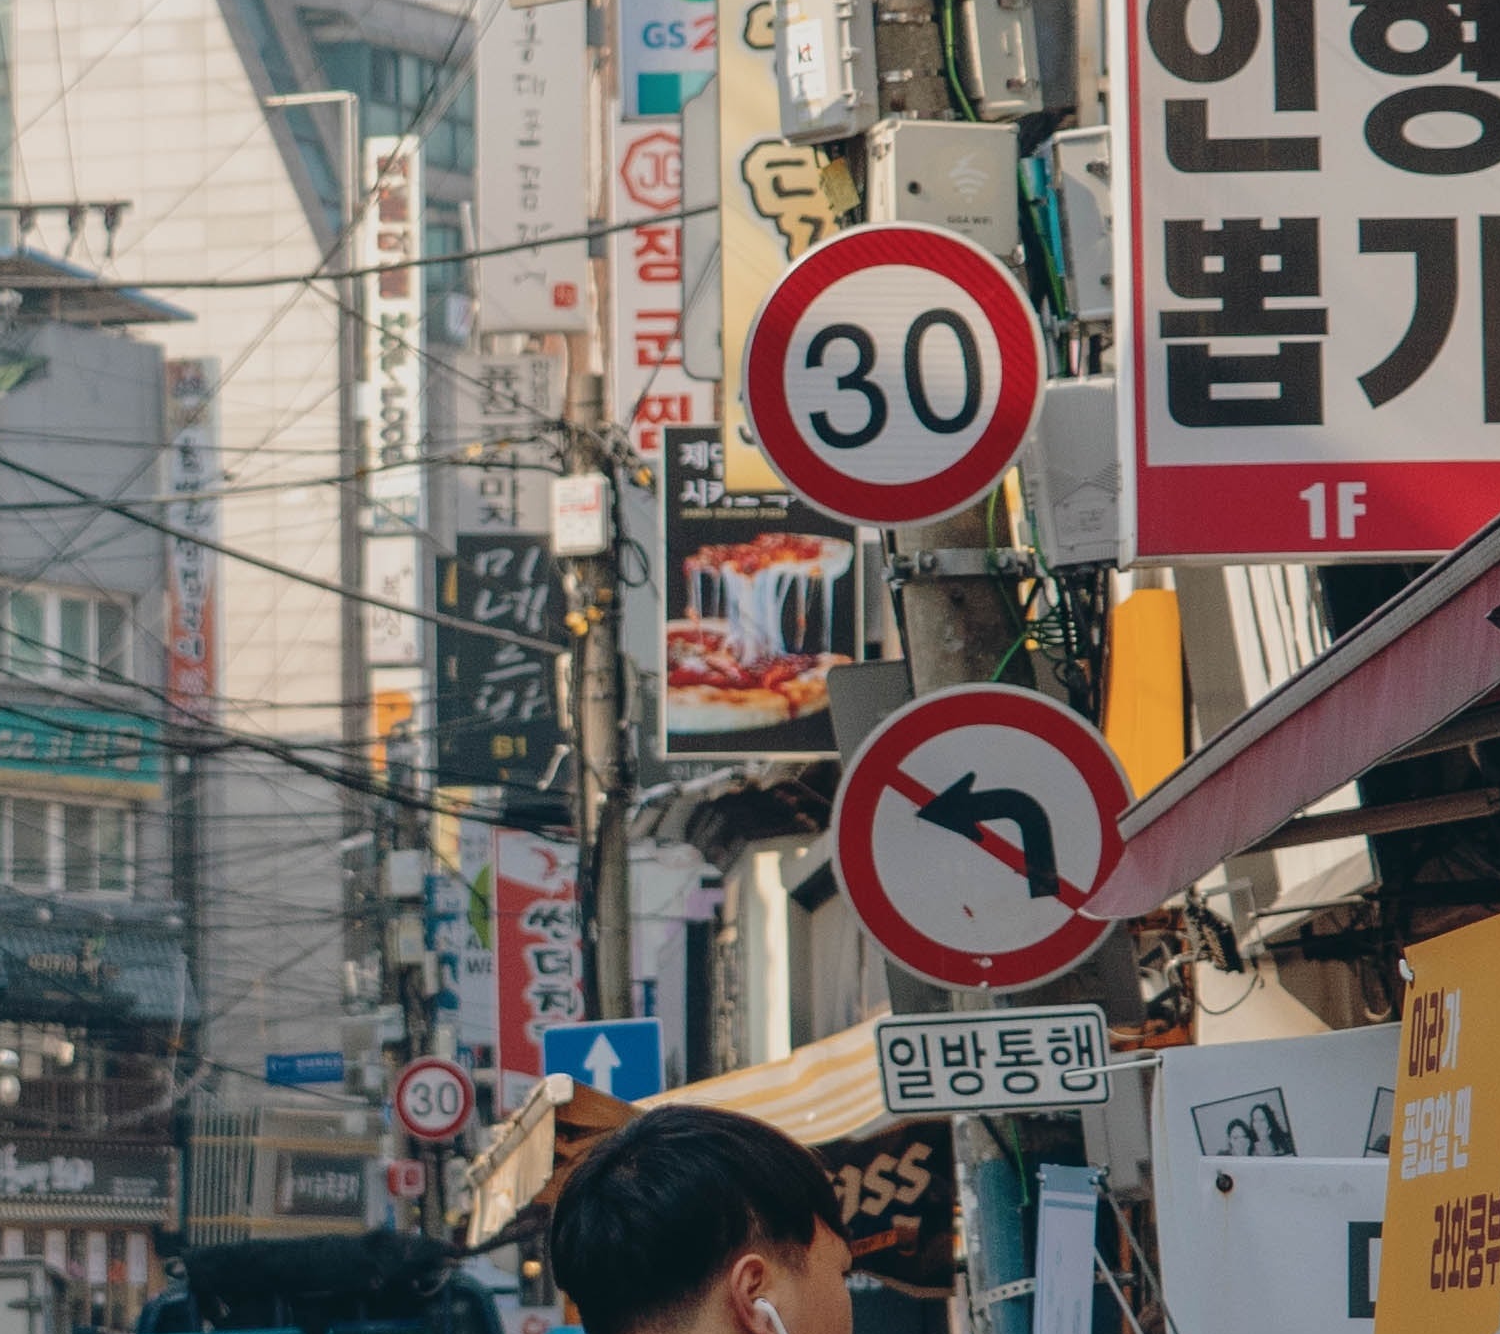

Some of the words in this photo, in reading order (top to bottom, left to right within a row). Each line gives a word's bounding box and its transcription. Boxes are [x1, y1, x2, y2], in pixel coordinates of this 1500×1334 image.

[804, 307, 984, 450] 30
[1298, 481, 1367, 542] 1F
[409, 1082, 460, 1117] 30
[886, 1021, 1100, 1106] 일방통행
